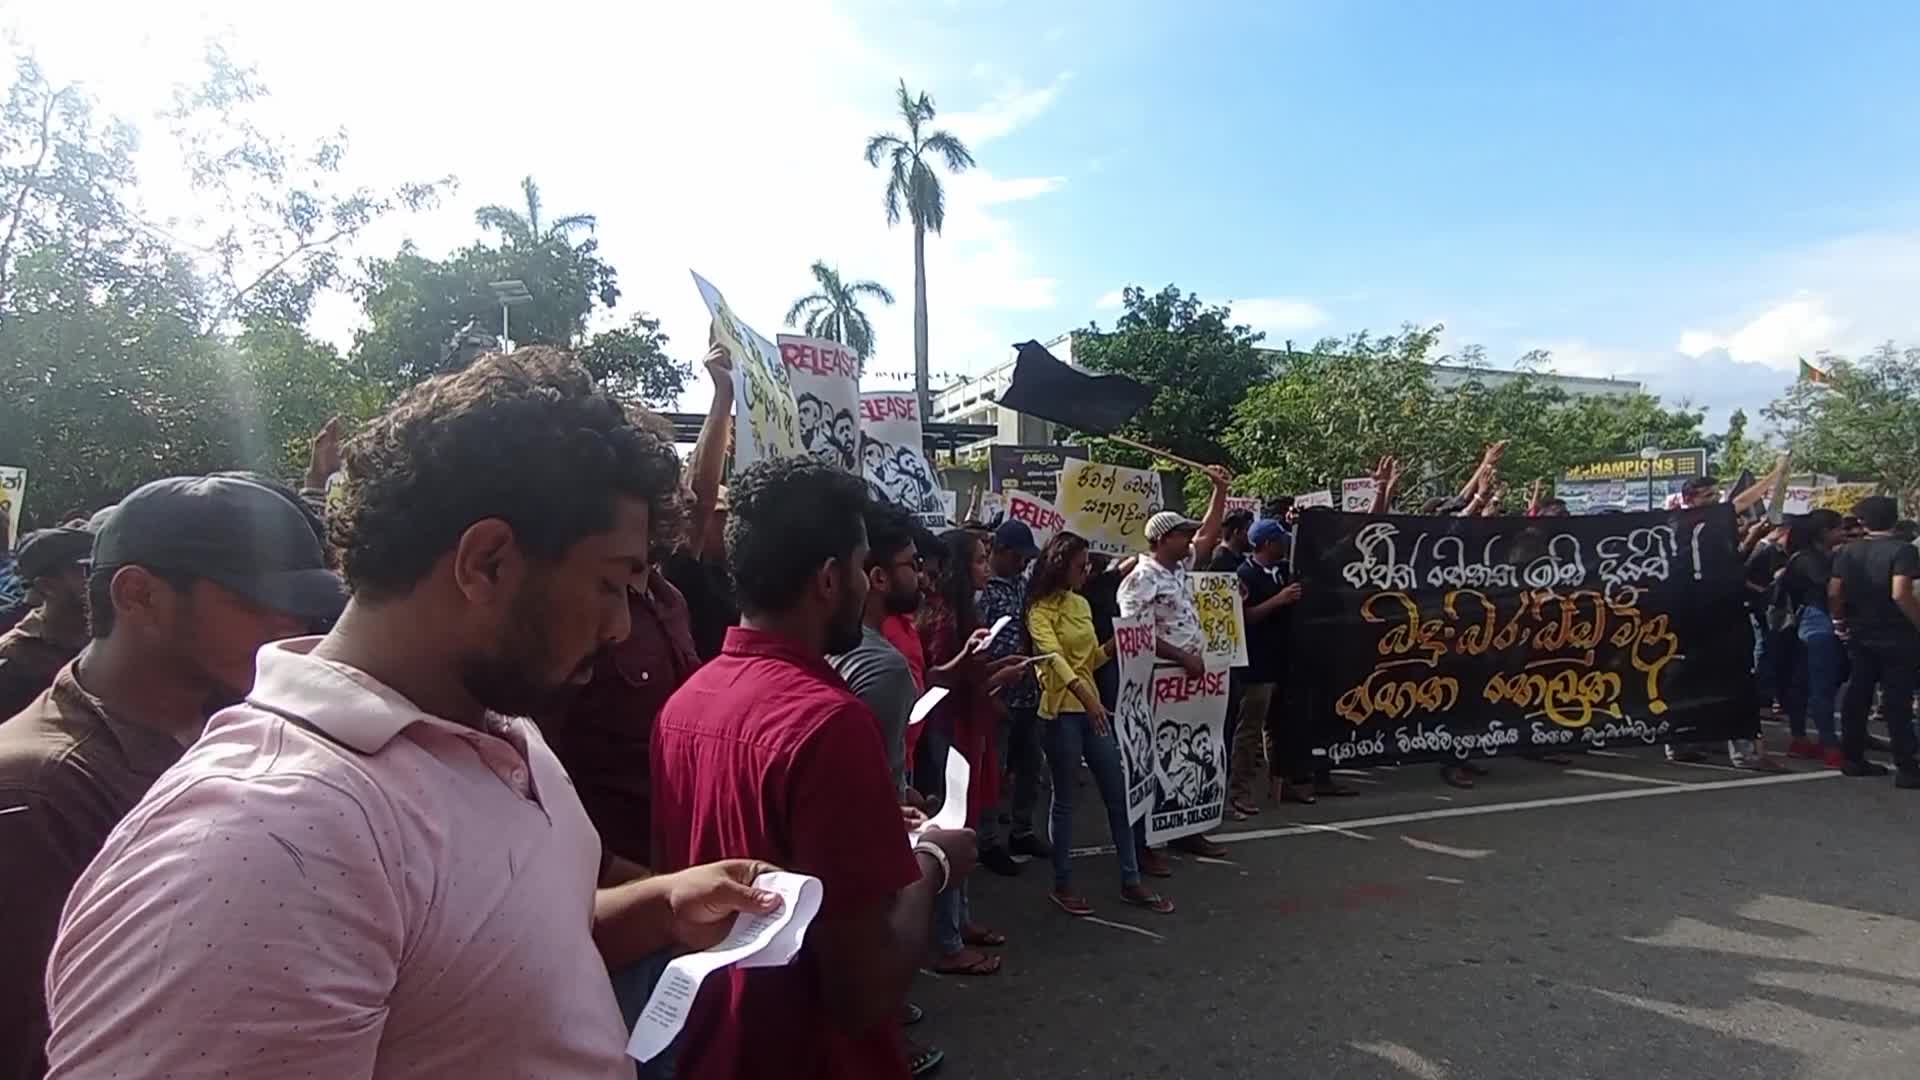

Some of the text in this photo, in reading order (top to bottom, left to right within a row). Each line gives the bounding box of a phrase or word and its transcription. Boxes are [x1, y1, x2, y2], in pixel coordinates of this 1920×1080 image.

[778, 343, 859, 382] RELEASE
[860, 397, 917, 422] ELEASE
[1009, 497, 1067, 534] RELEAS
[1153, 671, 1228, 706] RELEASE
